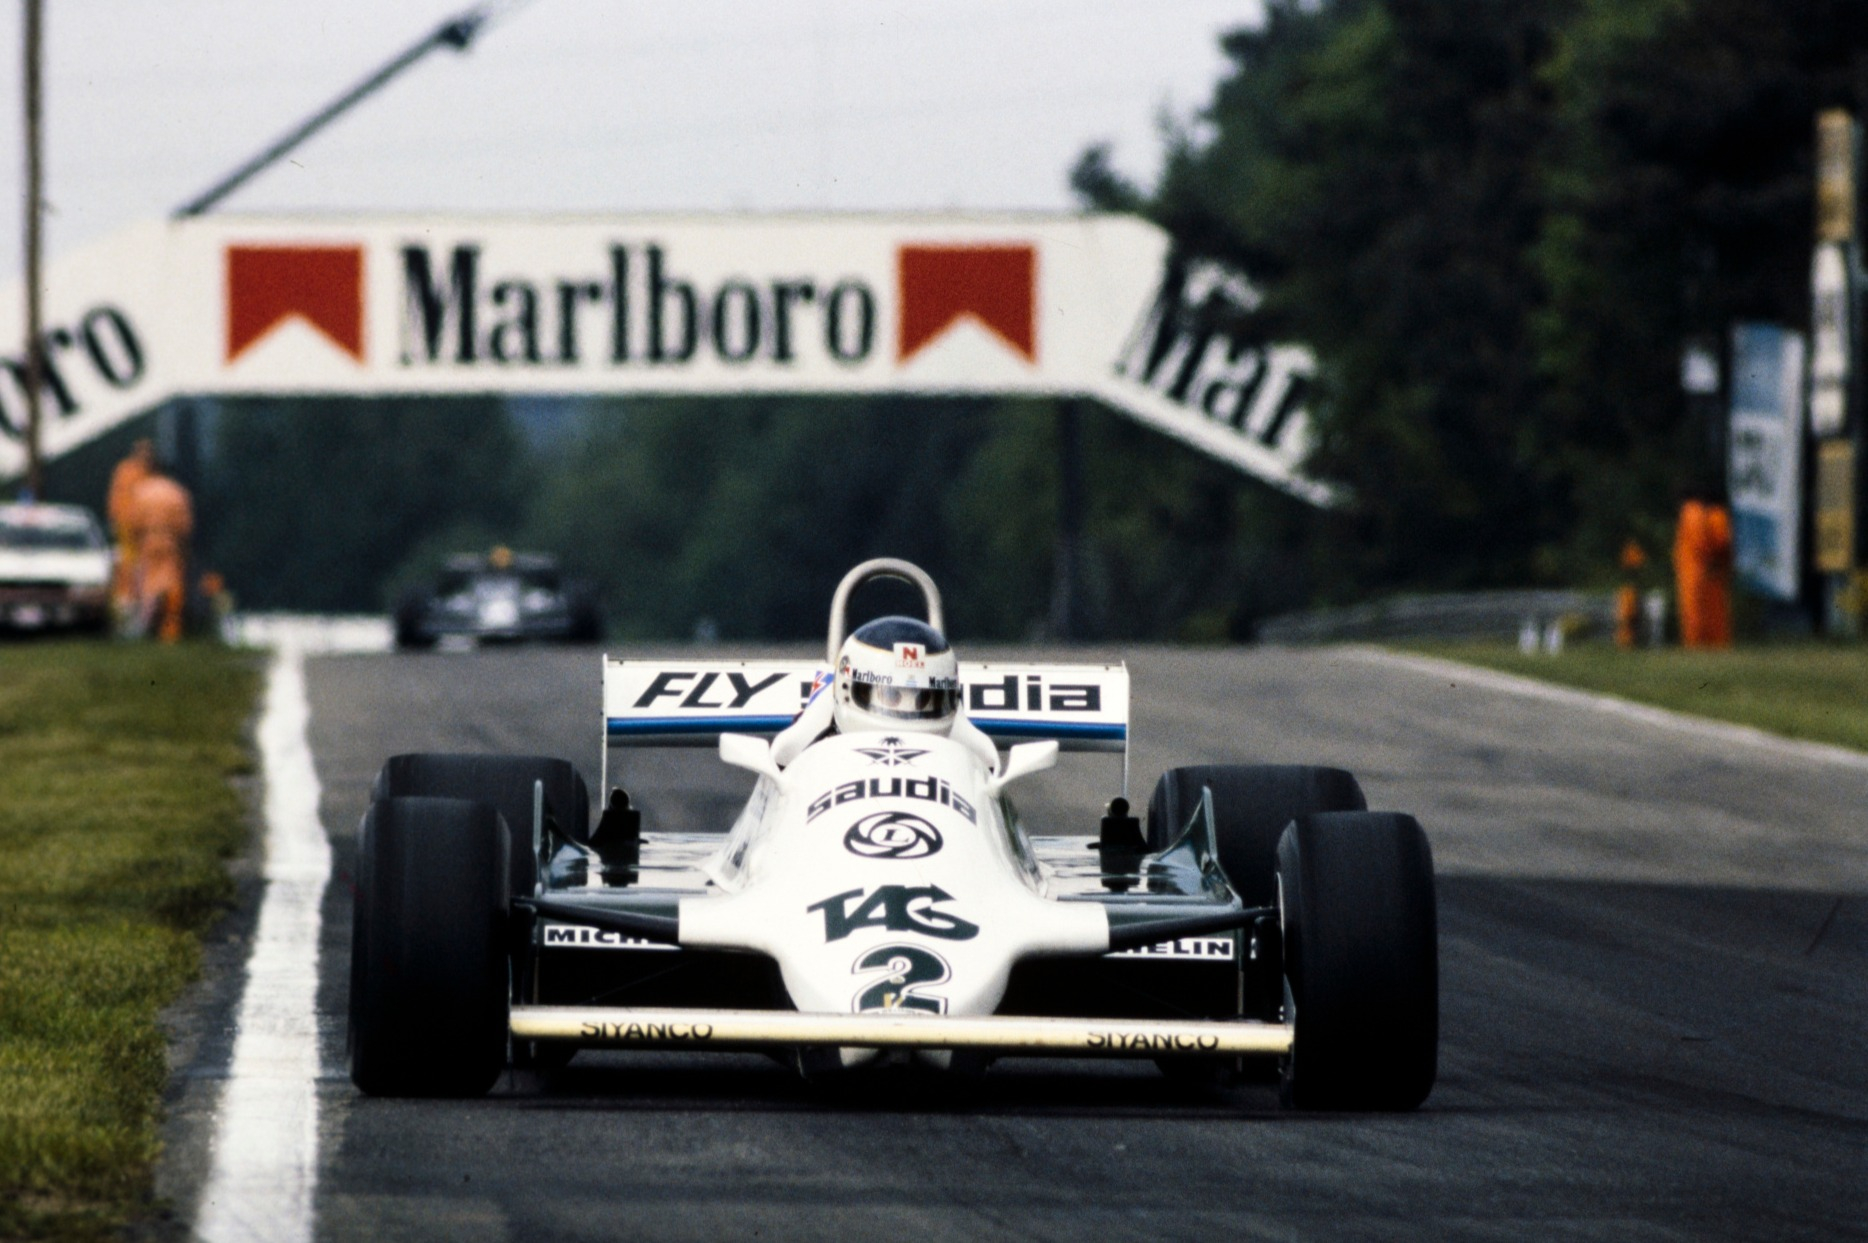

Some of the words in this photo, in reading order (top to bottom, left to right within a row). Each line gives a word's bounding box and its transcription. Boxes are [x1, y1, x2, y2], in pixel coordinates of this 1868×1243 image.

[399, 243, 879, 366] Marlboro
[903, 646, 917, 660] N
[632, 671, 792, 709] FLY
[852, 668, 893, 685] Marlboro
[806, 775, 977, 825] saudia
[881, 828, 910, 843] L
[806, 883, 980, 943] TAG
[851, 942, 952, 1014] 2
[581, 1021, 713, 1040] SIYANCO
[1087, 1031, 1219, 1050] SIYANCO
